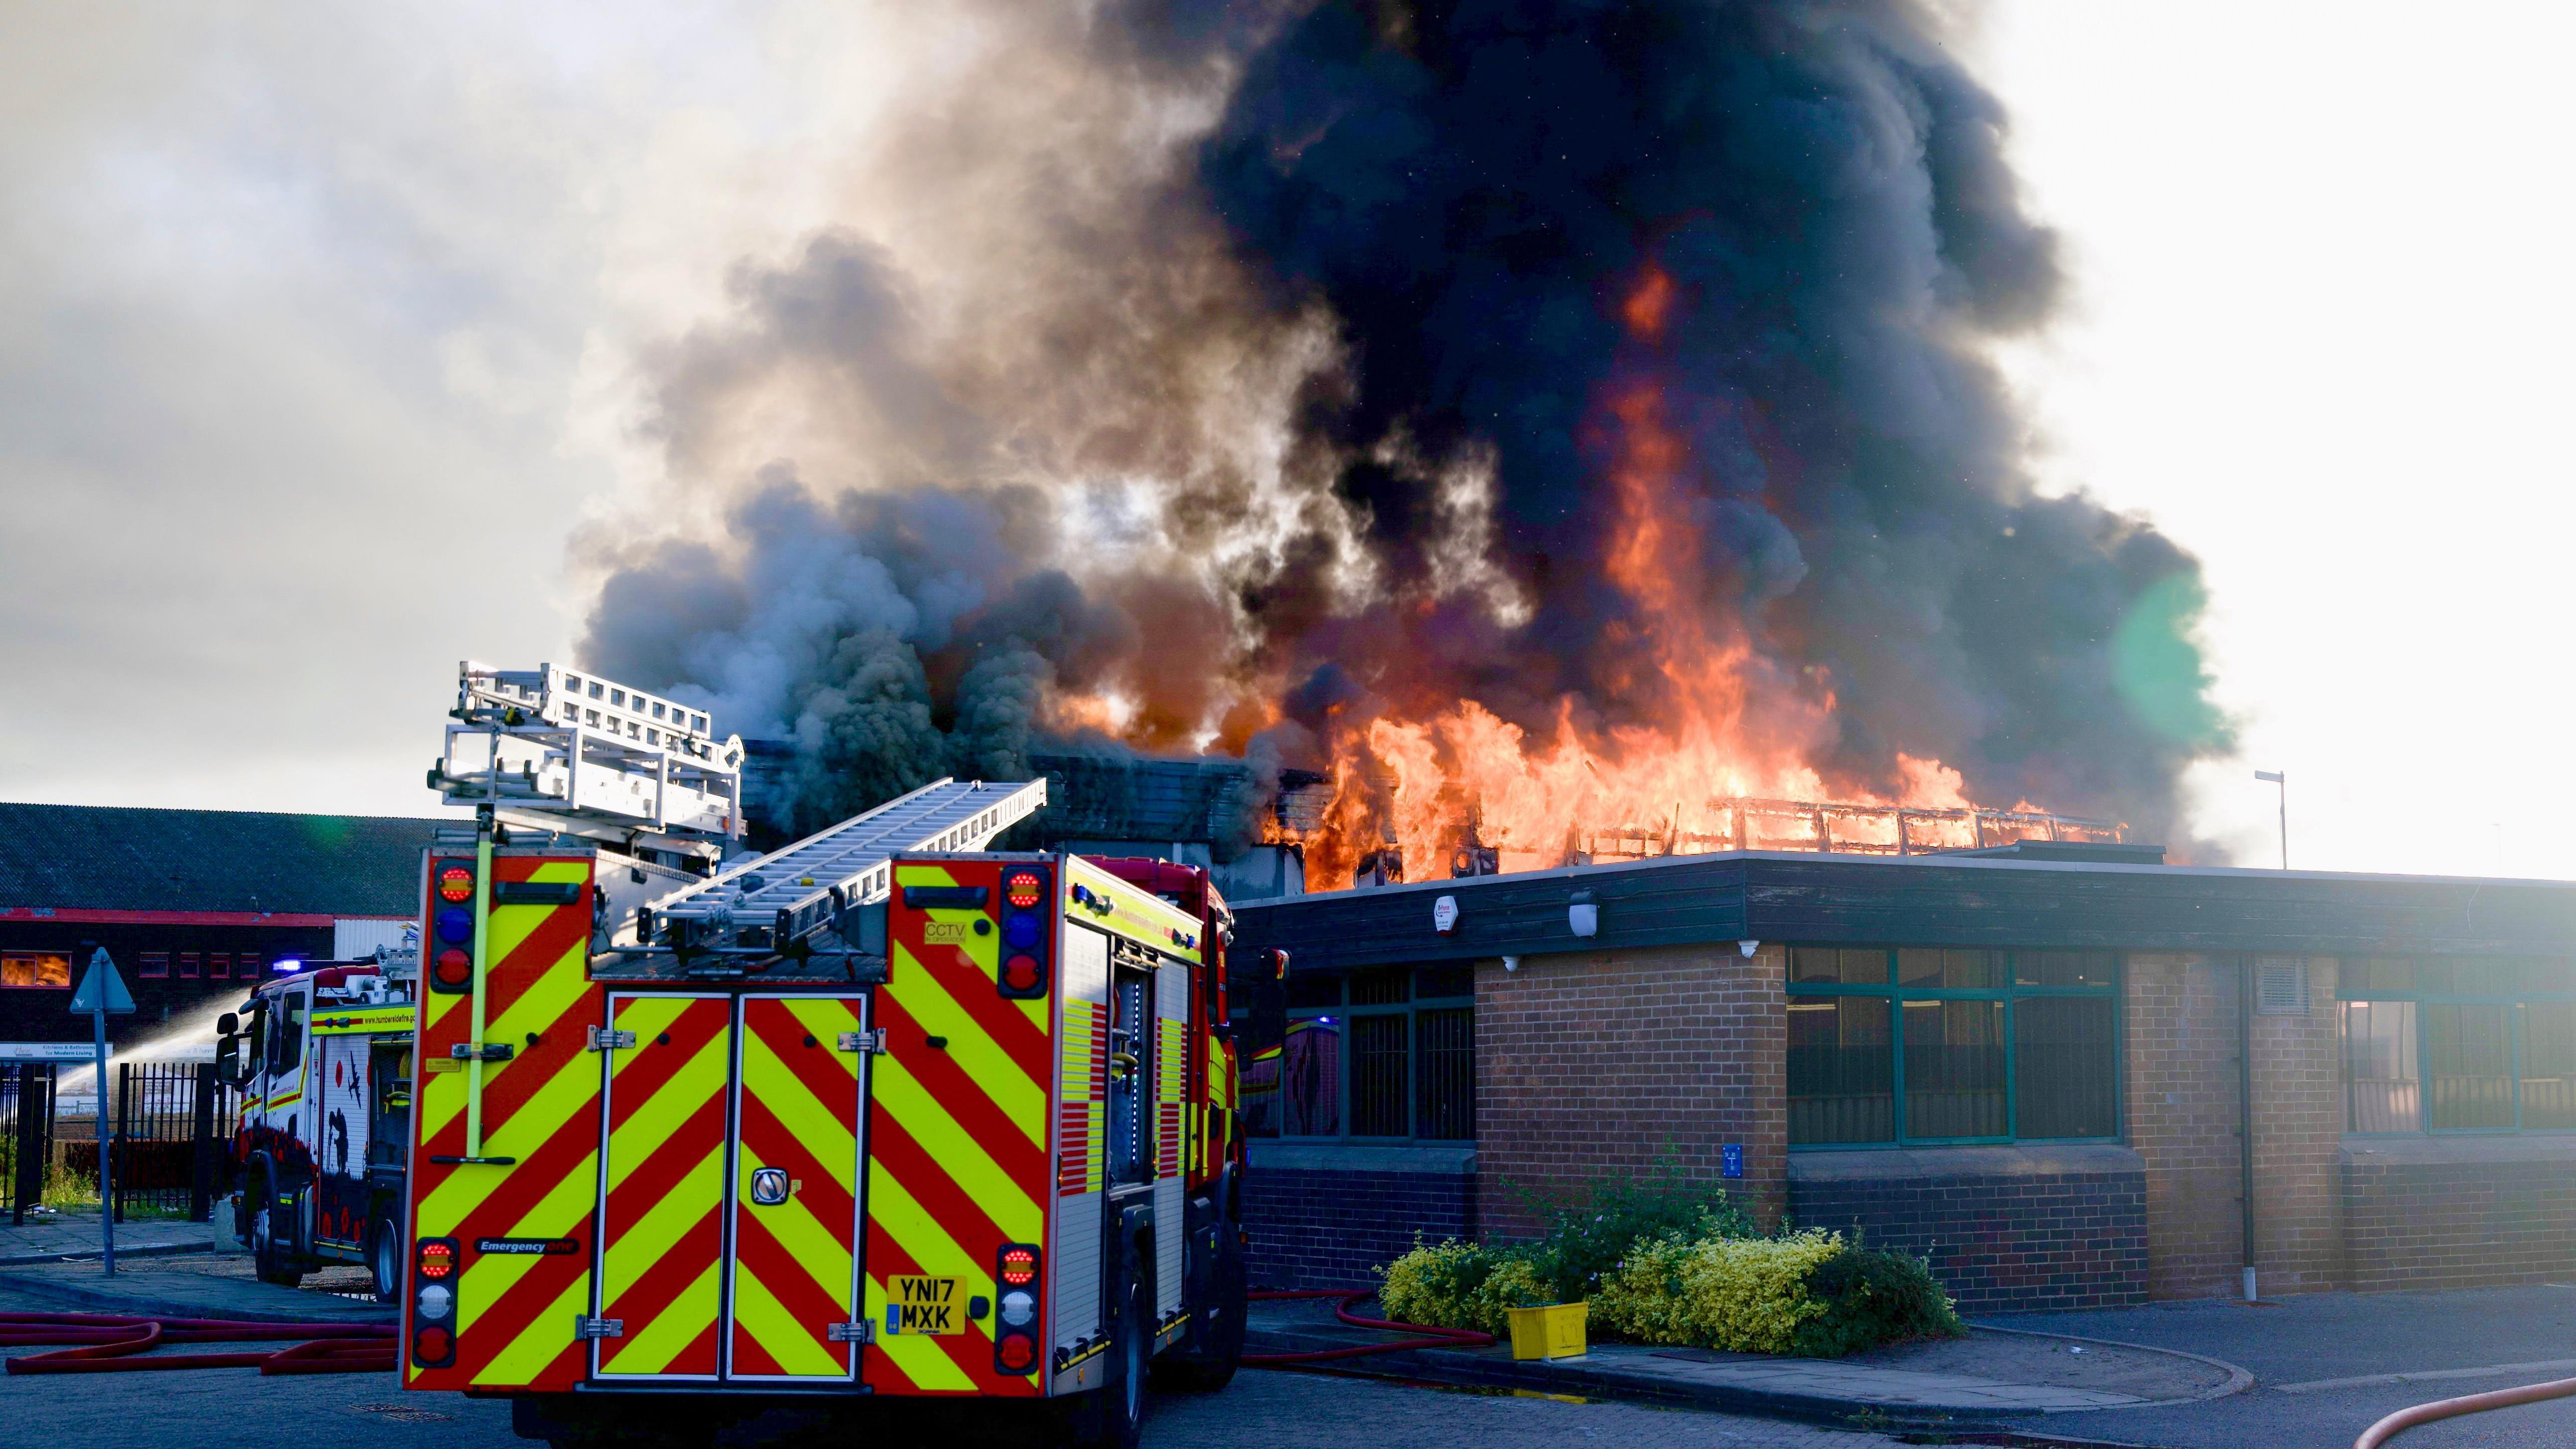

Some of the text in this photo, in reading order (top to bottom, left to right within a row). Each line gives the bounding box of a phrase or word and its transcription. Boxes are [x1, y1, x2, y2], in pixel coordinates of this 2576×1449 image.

[926, 924, 965, 936] CCTV
[481, 1242, 546, 1253] Emergency
[901, 1279, 954, 1302] YN17
[902, 1305, 951, 1328] MXK
